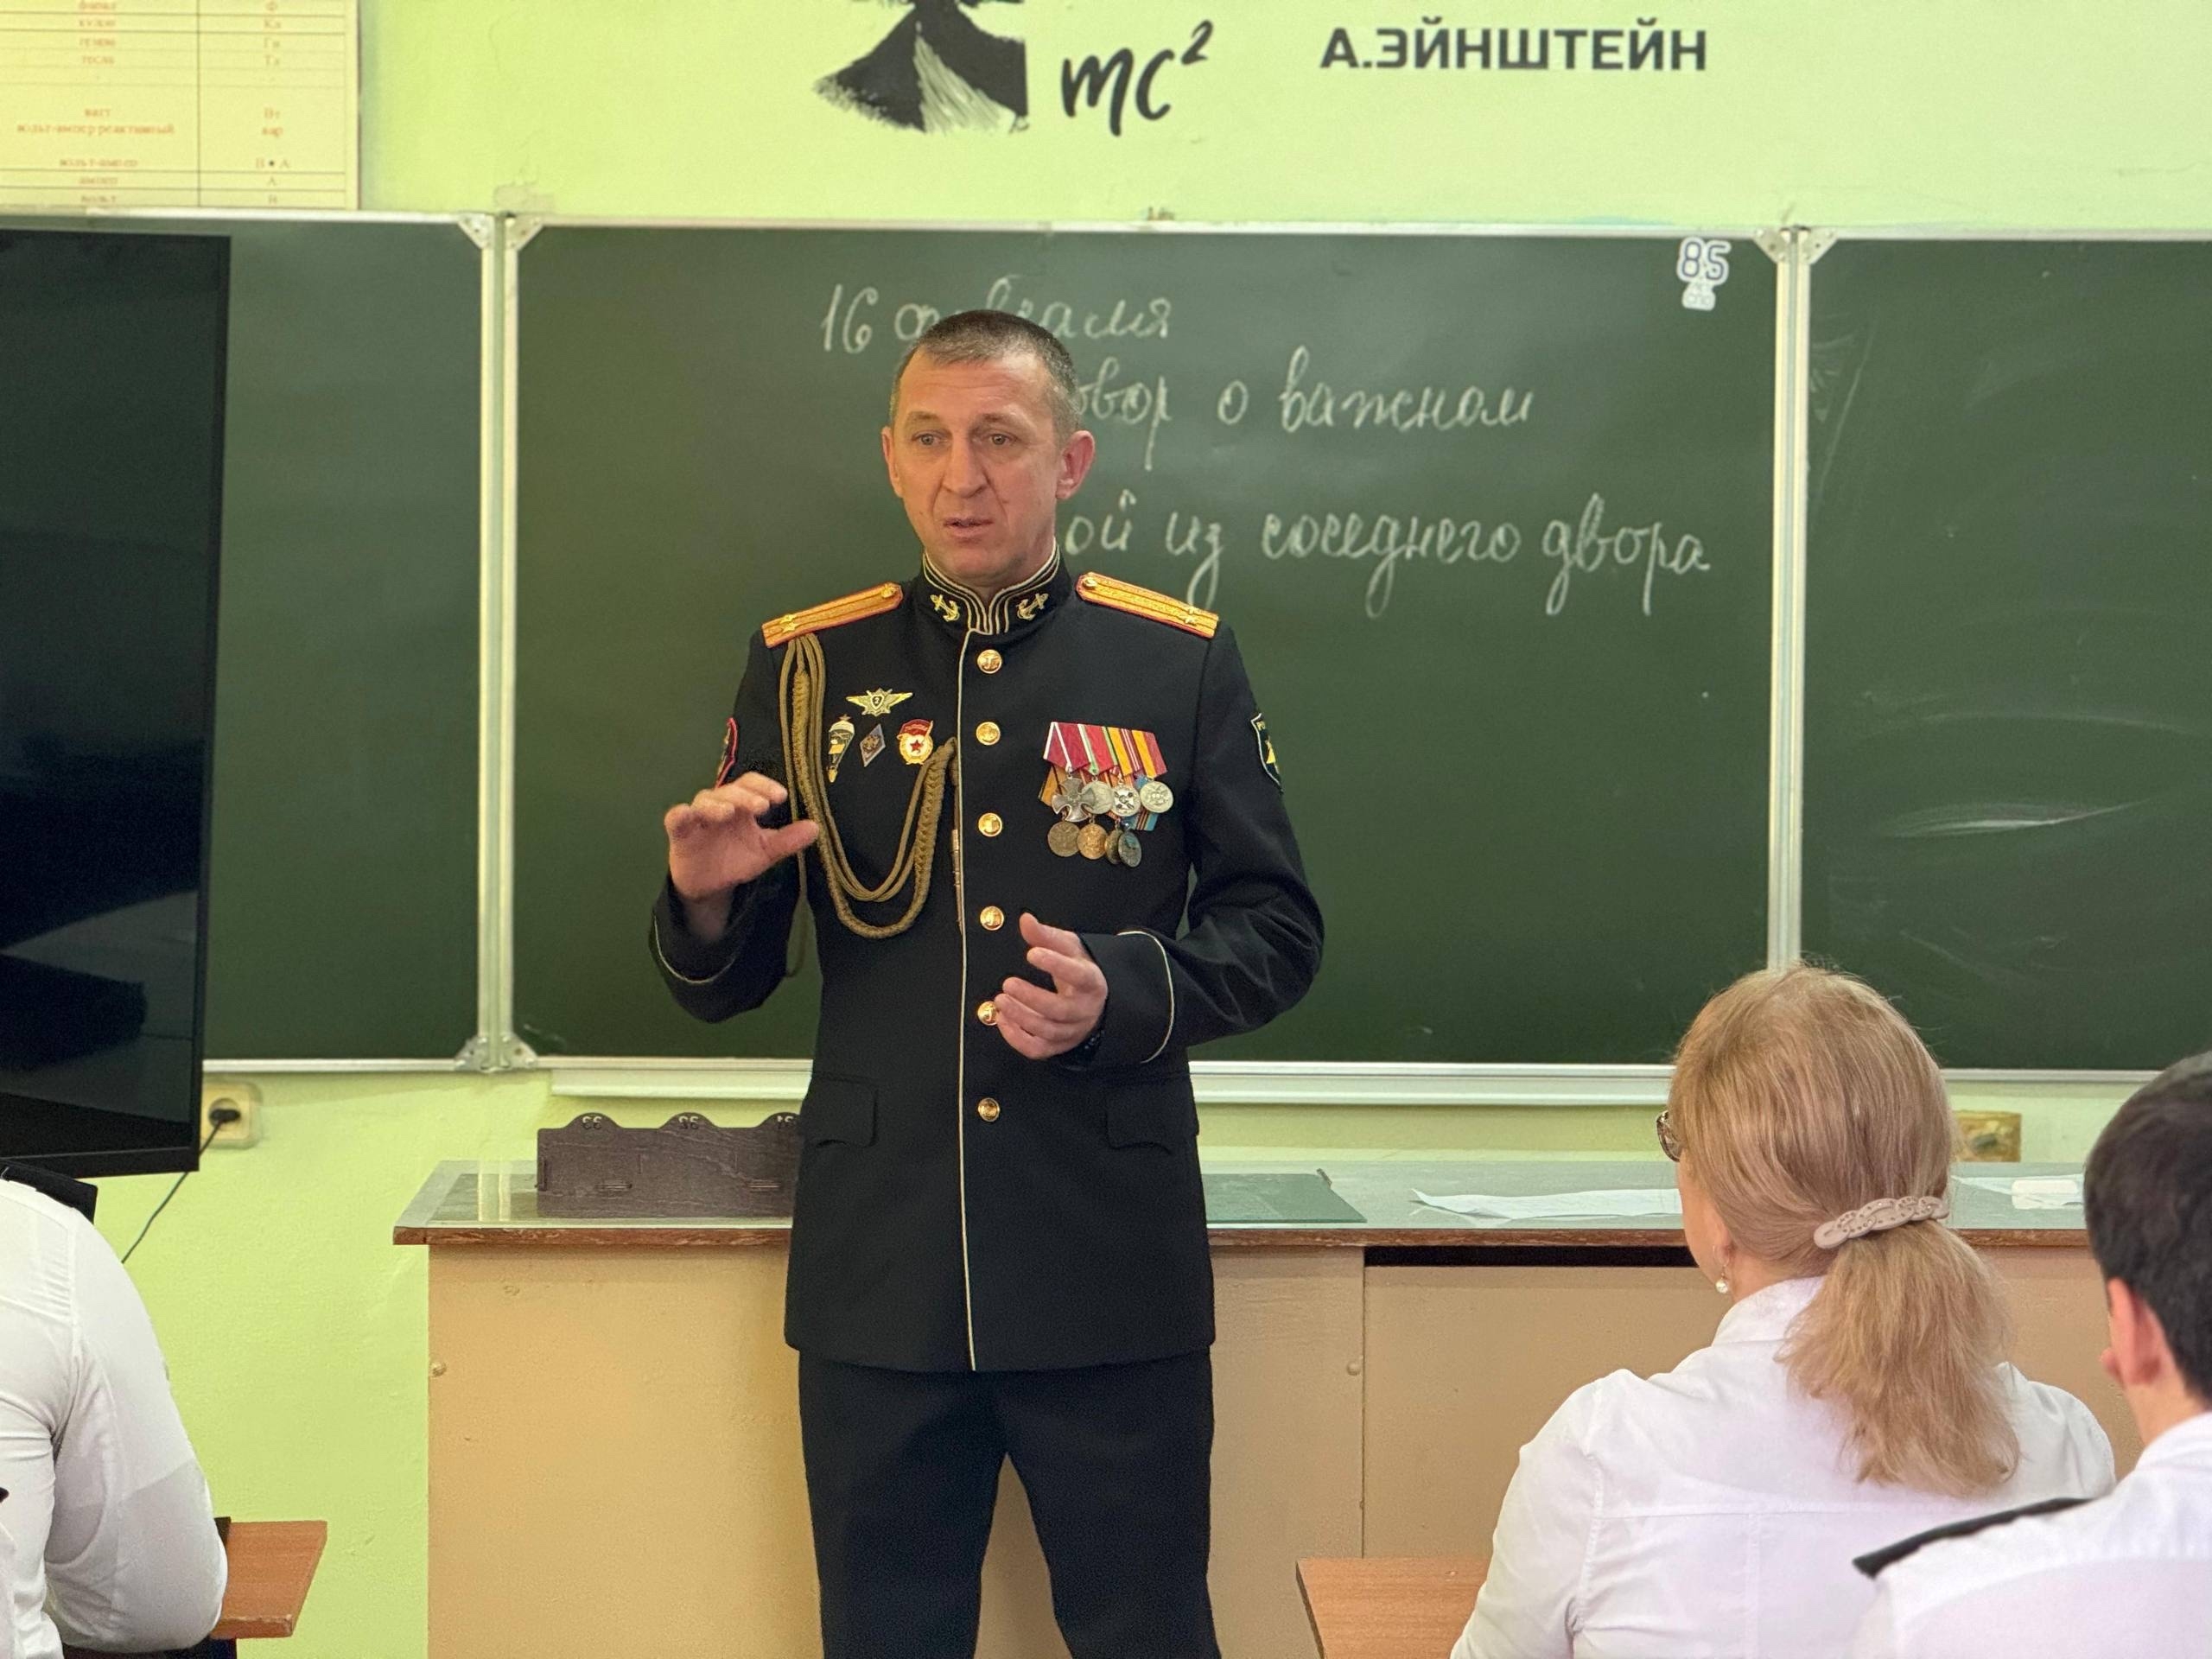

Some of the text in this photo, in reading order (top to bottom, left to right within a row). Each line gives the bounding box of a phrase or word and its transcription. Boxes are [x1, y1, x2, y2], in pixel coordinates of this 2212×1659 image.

[1320, 16, 1706, 71] А.ЭЙНШТЕЙН
[1679, 238, 1730, 284] 85
[821, 284, 878, 353] 16
[1217, 380, 1249, 424] о
[1279, 345, 1535, 432] важном
[1166, 511, 1224, 610] из
[1261, 512, 1522, 620] соседнего
[1541, 493, 1712, 616] двора
